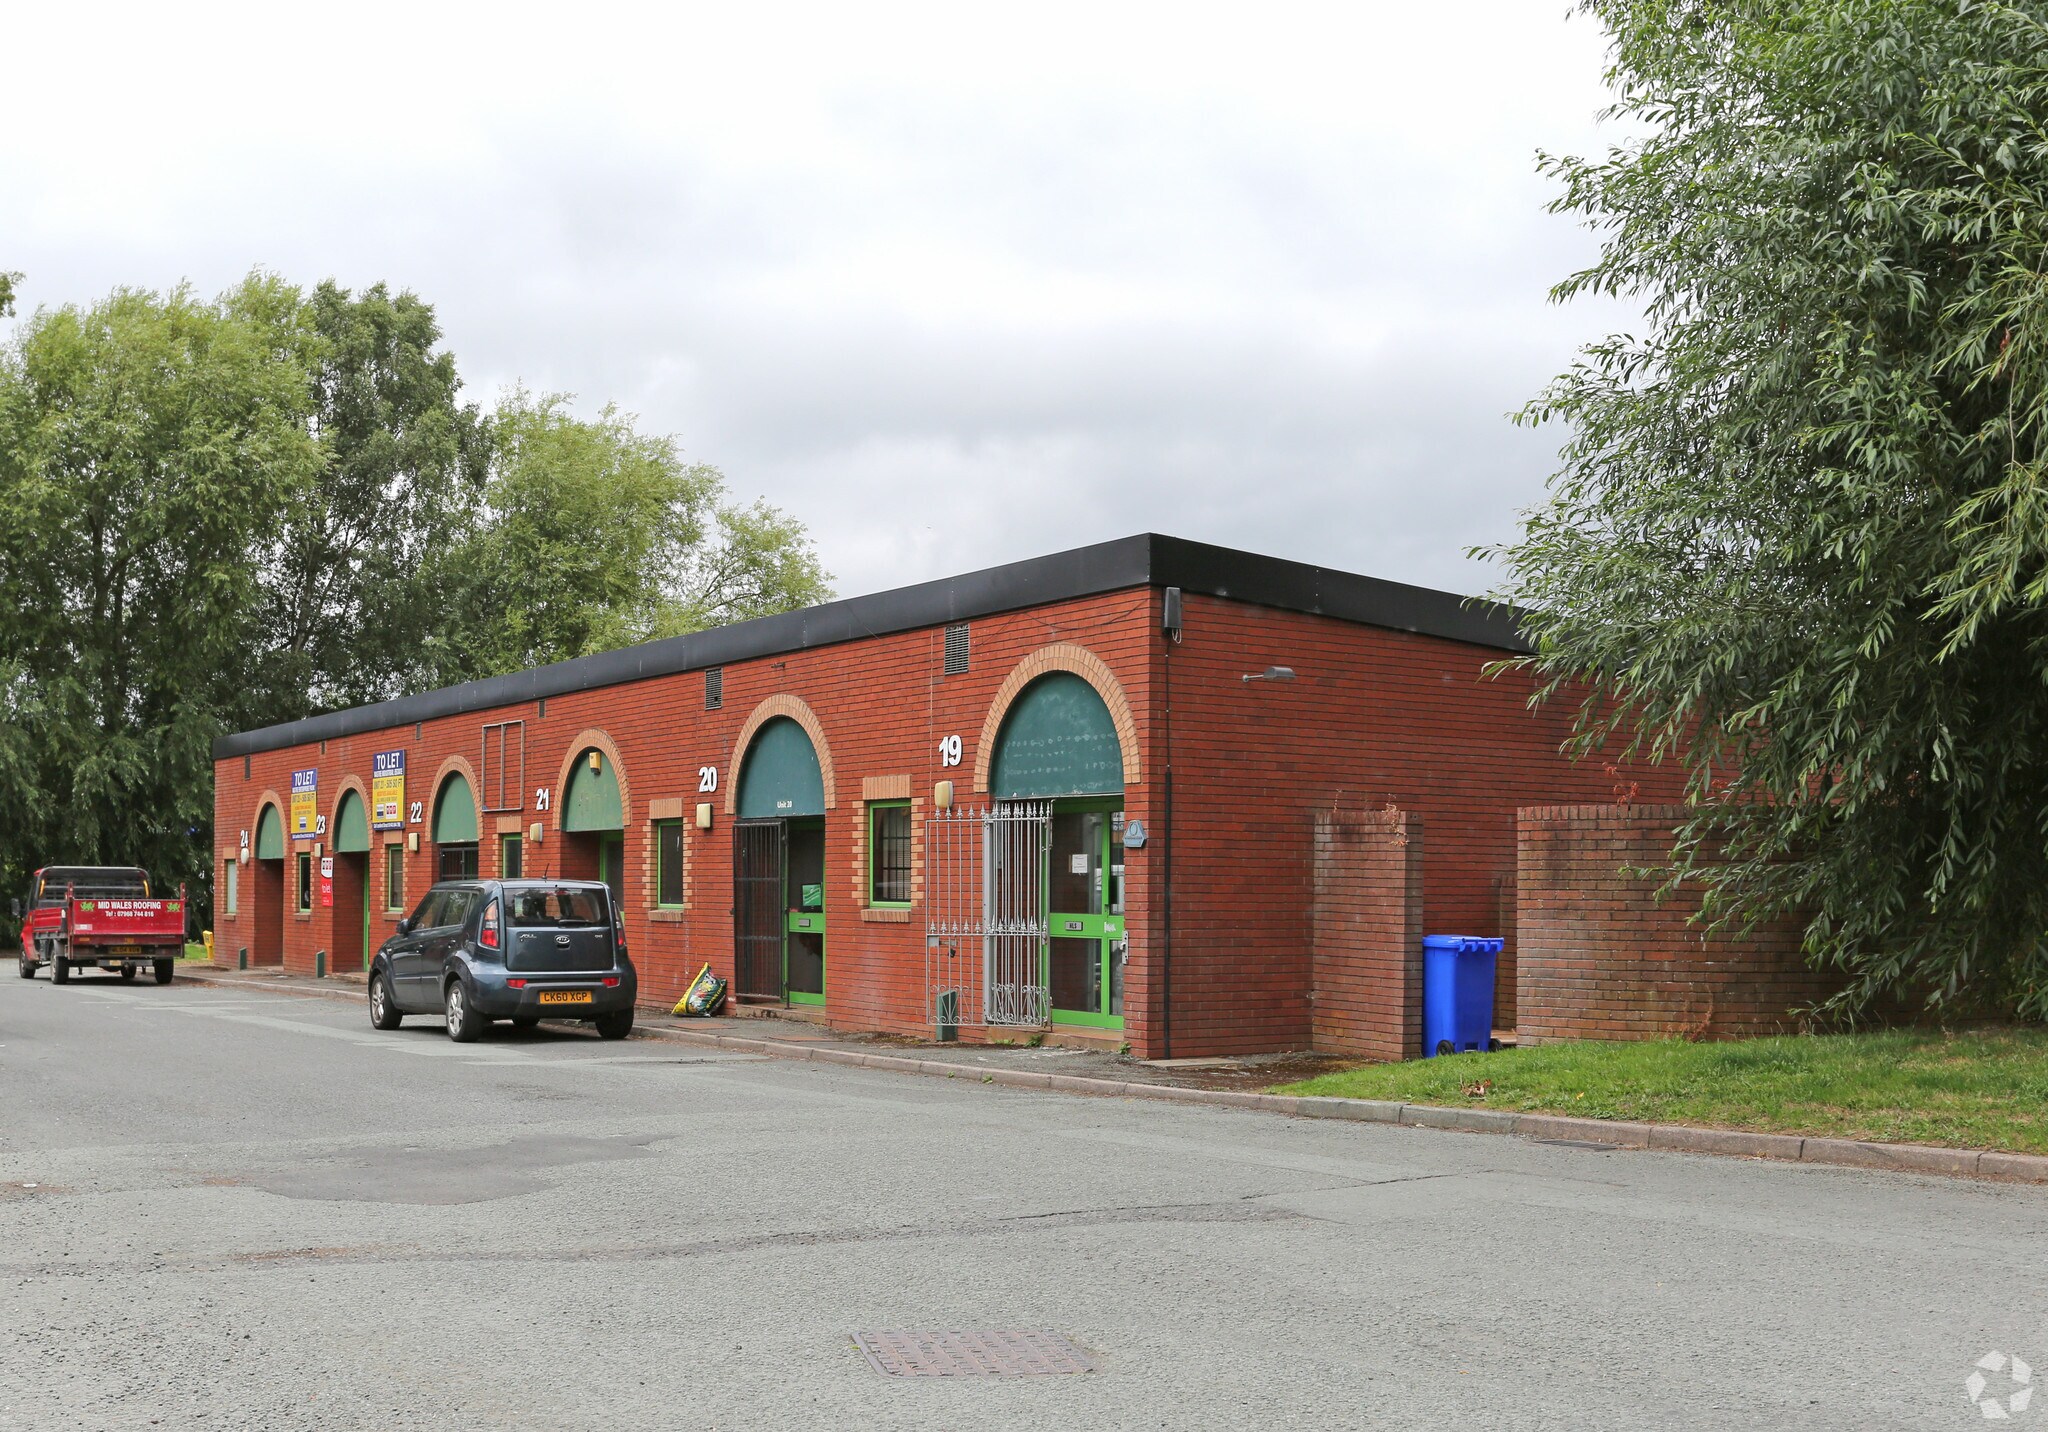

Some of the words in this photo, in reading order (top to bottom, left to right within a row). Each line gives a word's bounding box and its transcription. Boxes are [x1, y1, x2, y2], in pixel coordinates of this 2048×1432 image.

[938, 734, 962, 767] 19
[376, 754, 386, 770] TO
[387, 752, 400, 768] LET
[294, 772, 302, 787] TO
[302, 771, 314, 786] LET
[698, 766, 718, 792] 20
[536, 788, 549, 810] 21
[776, 801, 786, 809] Unit
[786, 800, 793, 808] 20
[410, 801, 422, 823] 22
[316, 815, 326, 834] 23
[240, 829, 249, 847] 24
[97, 901, 110, 909] MID
[111, 901, 132, 909] WALES
[133, 901, 161, 910] ROOFING
[543, 993, 568, 1002] CK60
[570, 993, 588, 1001] XGP
